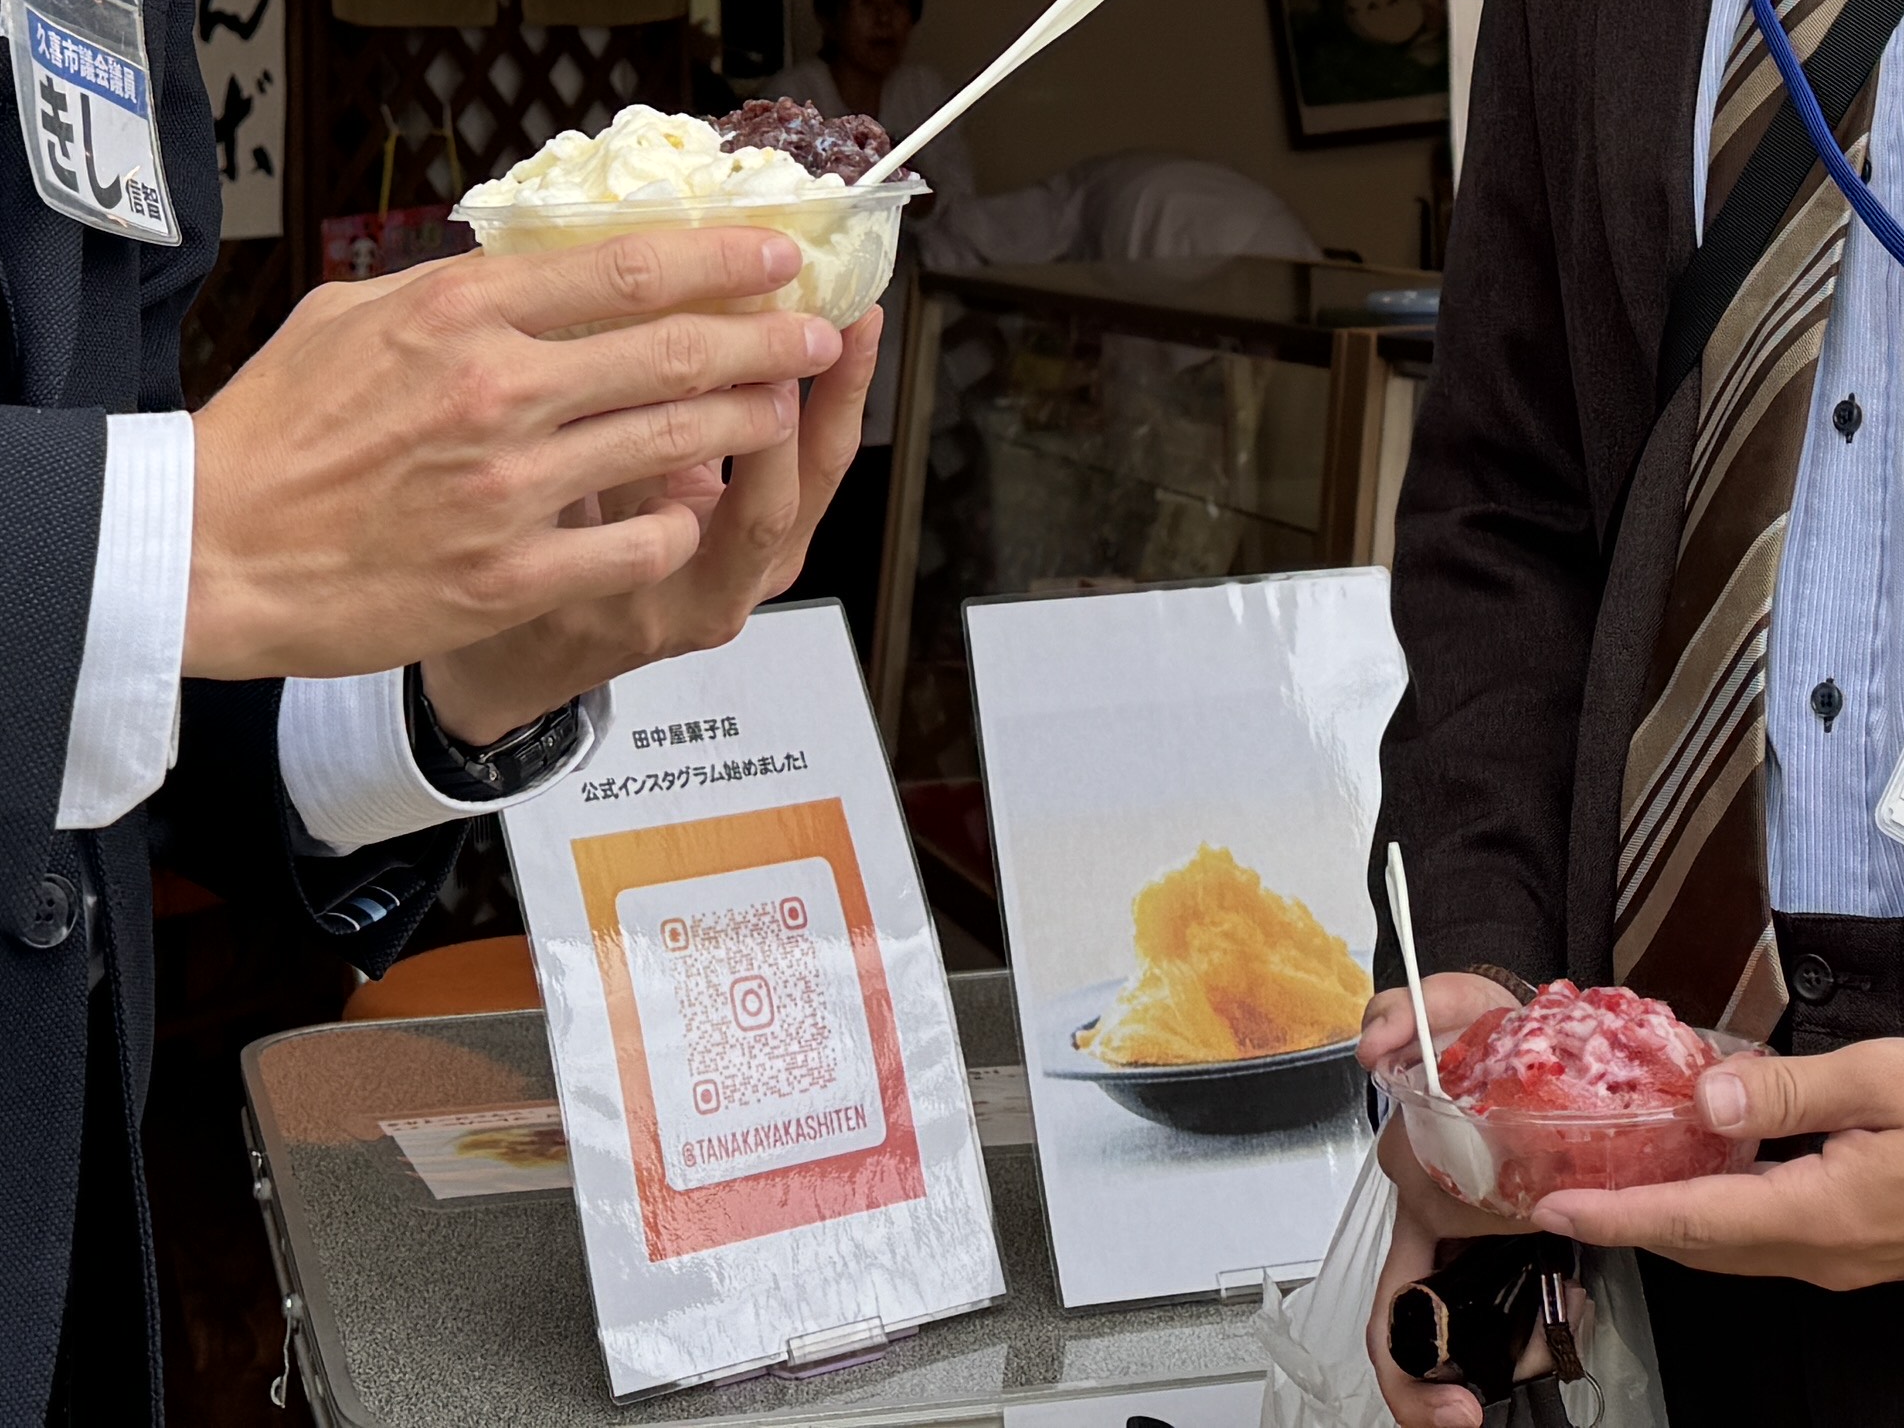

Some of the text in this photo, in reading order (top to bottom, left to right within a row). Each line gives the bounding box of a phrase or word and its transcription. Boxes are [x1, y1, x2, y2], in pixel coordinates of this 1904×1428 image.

[35, 27, 137, 104] 久喜市議会議員
[39, 74, 121, 210] きし
[631, 715, 740, 750] 田中屋菓子店
[681, 1102, 868, 1169] @TANAKAYAKASHITEN
